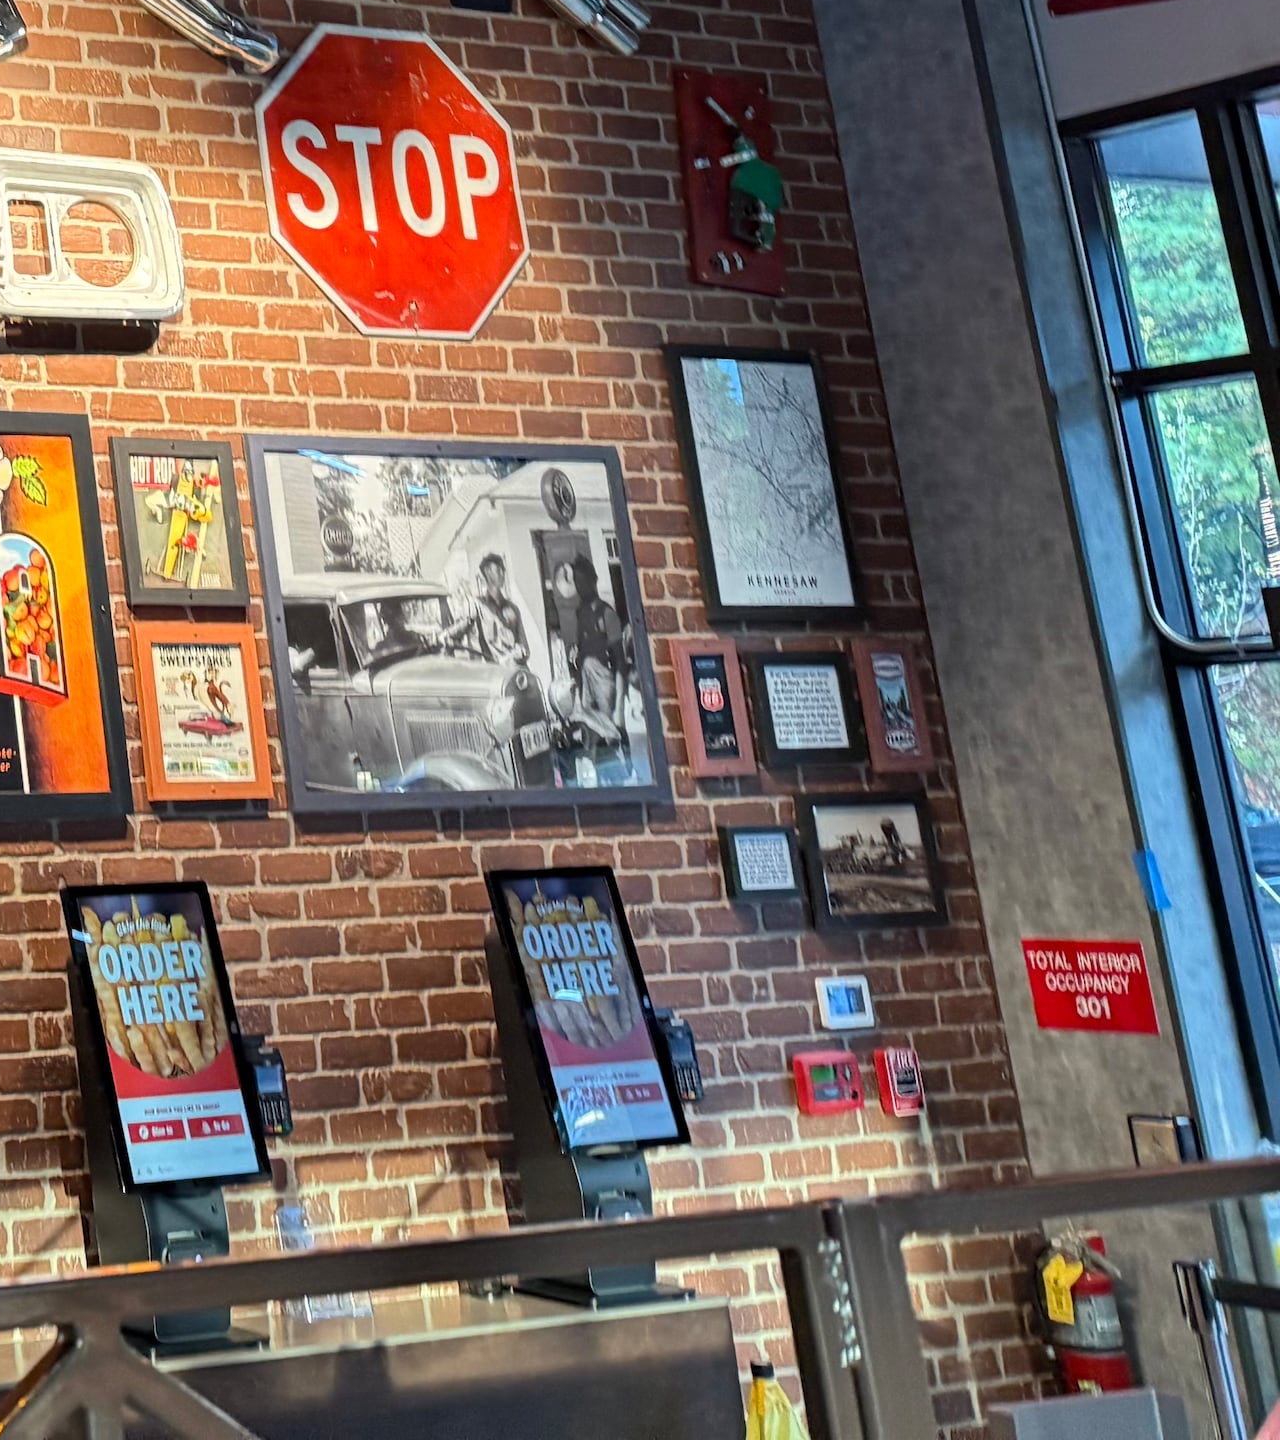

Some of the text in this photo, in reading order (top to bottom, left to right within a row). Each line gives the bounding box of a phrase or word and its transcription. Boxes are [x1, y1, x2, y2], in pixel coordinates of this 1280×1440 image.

[281, 119, 500, 241] STOP
[130, 455, 151, 484] HOT
[747, 574, 818, 588] KENNESAW
[522, 921, 617, 960] ORDER
[98, 940, 206, 984] ORDER
[1026, 950, 1142, 974] TOTAL INTERIOR
[1045, 971, 1129, 995] OCCUPANCY
[117, 982, 204, 1026] HERE
